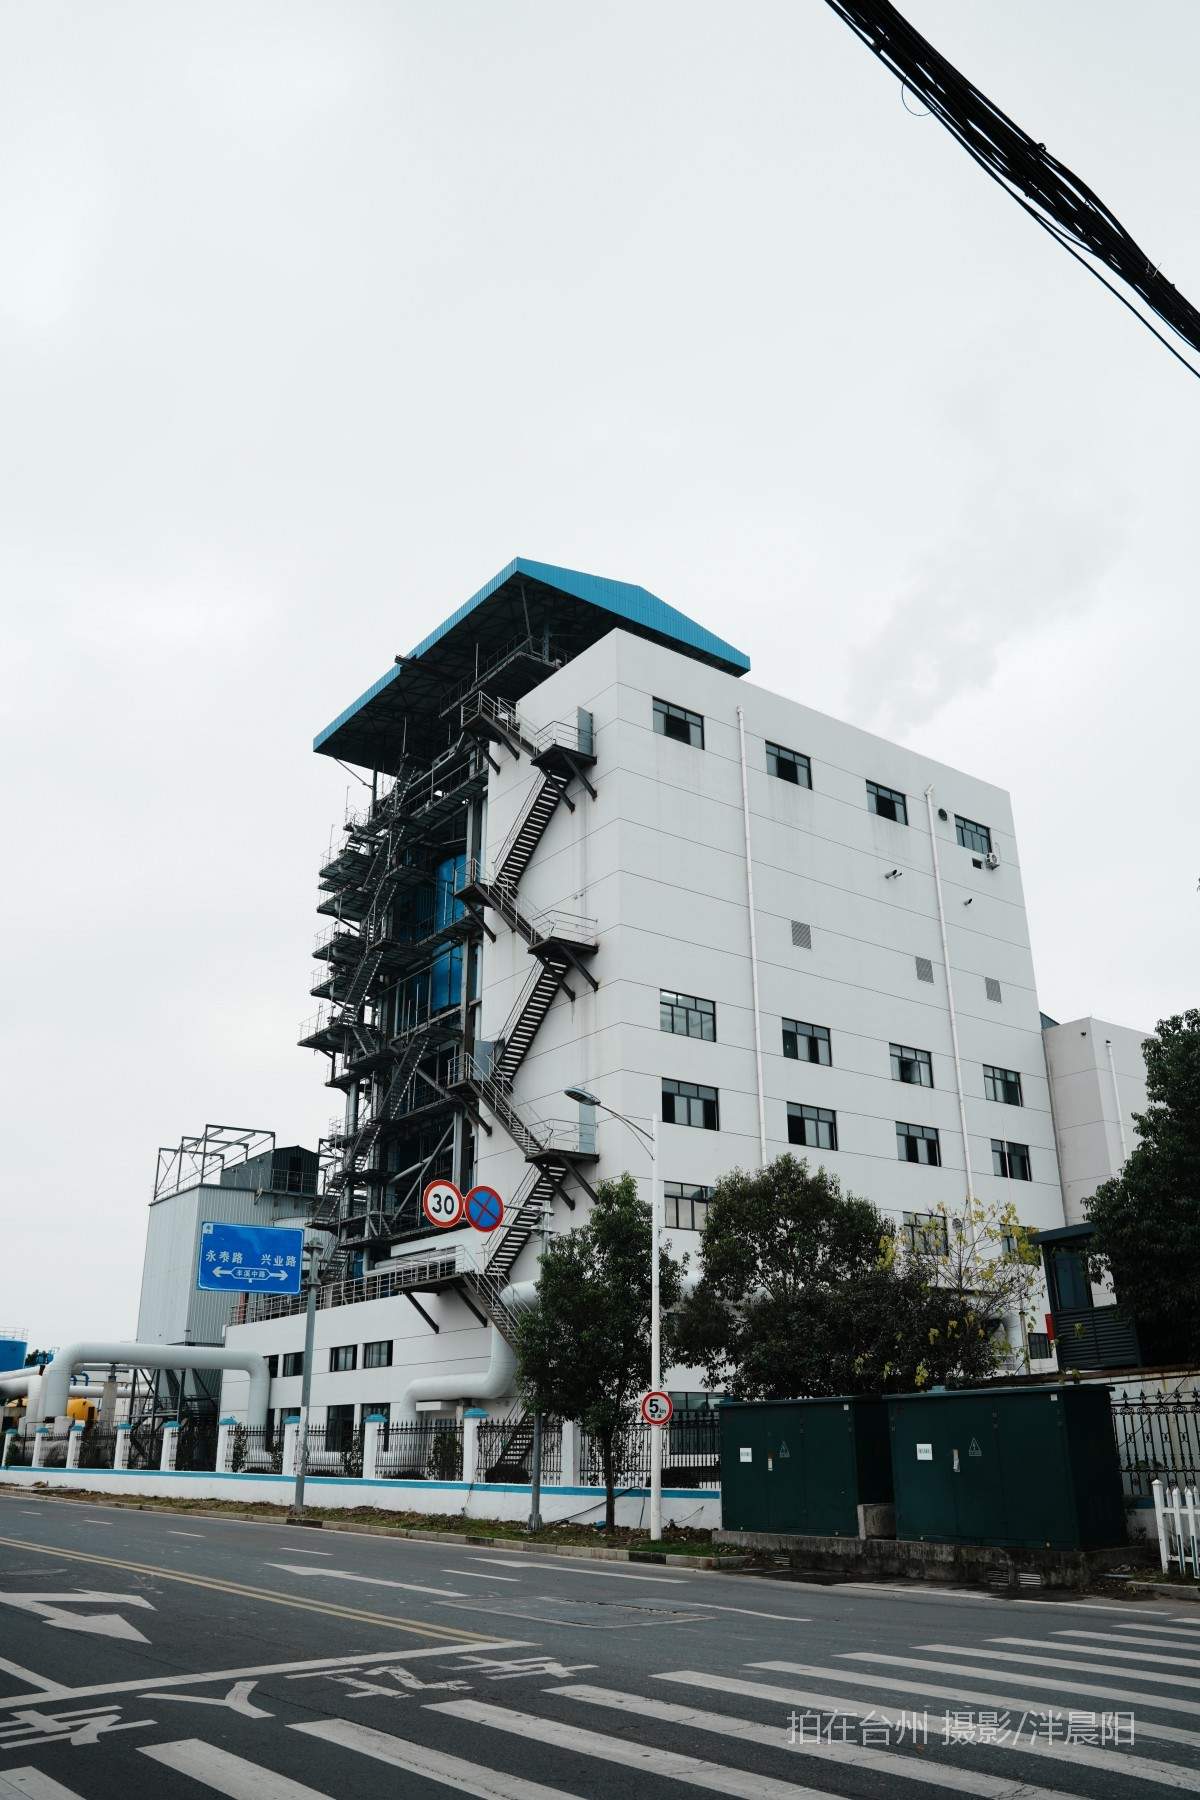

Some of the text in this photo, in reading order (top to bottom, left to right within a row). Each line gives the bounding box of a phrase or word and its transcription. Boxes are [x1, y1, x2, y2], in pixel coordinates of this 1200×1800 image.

[432, 1194, 454, 1215] 30
[206, 1251, 296, 1267] 永泰路 兴业路
